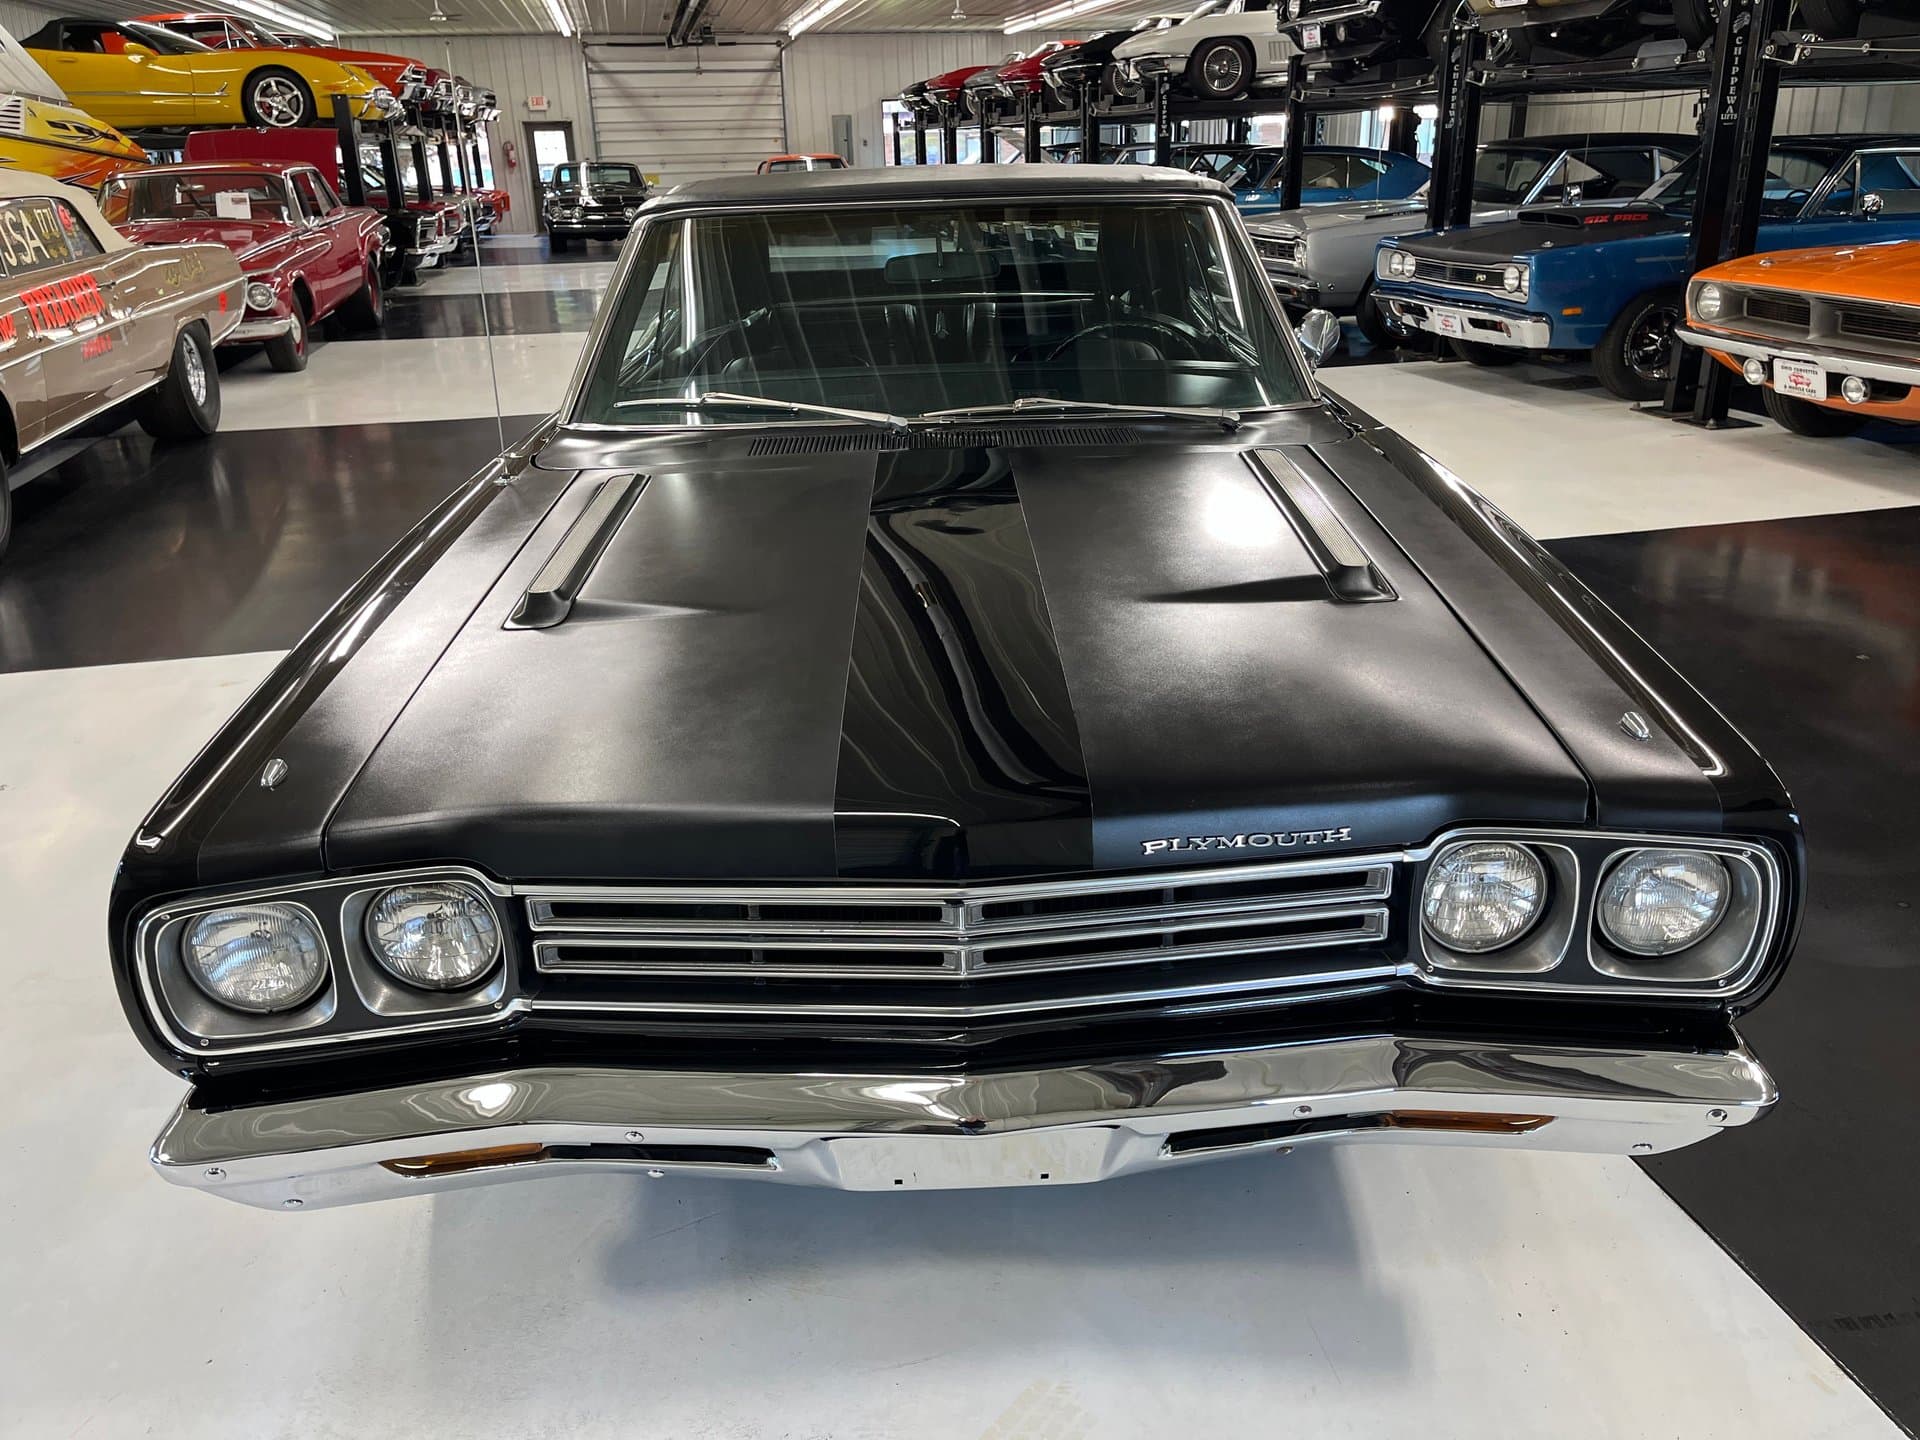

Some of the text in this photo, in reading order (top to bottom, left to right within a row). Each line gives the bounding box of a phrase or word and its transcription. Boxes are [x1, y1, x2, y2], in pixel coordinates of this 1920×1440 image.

[1726, 36, 1743, 113] CHIPPEWA
[1583, 214, 1609, 224] SIX
[1142, 827, 1352, 855] PLYMOUTH
